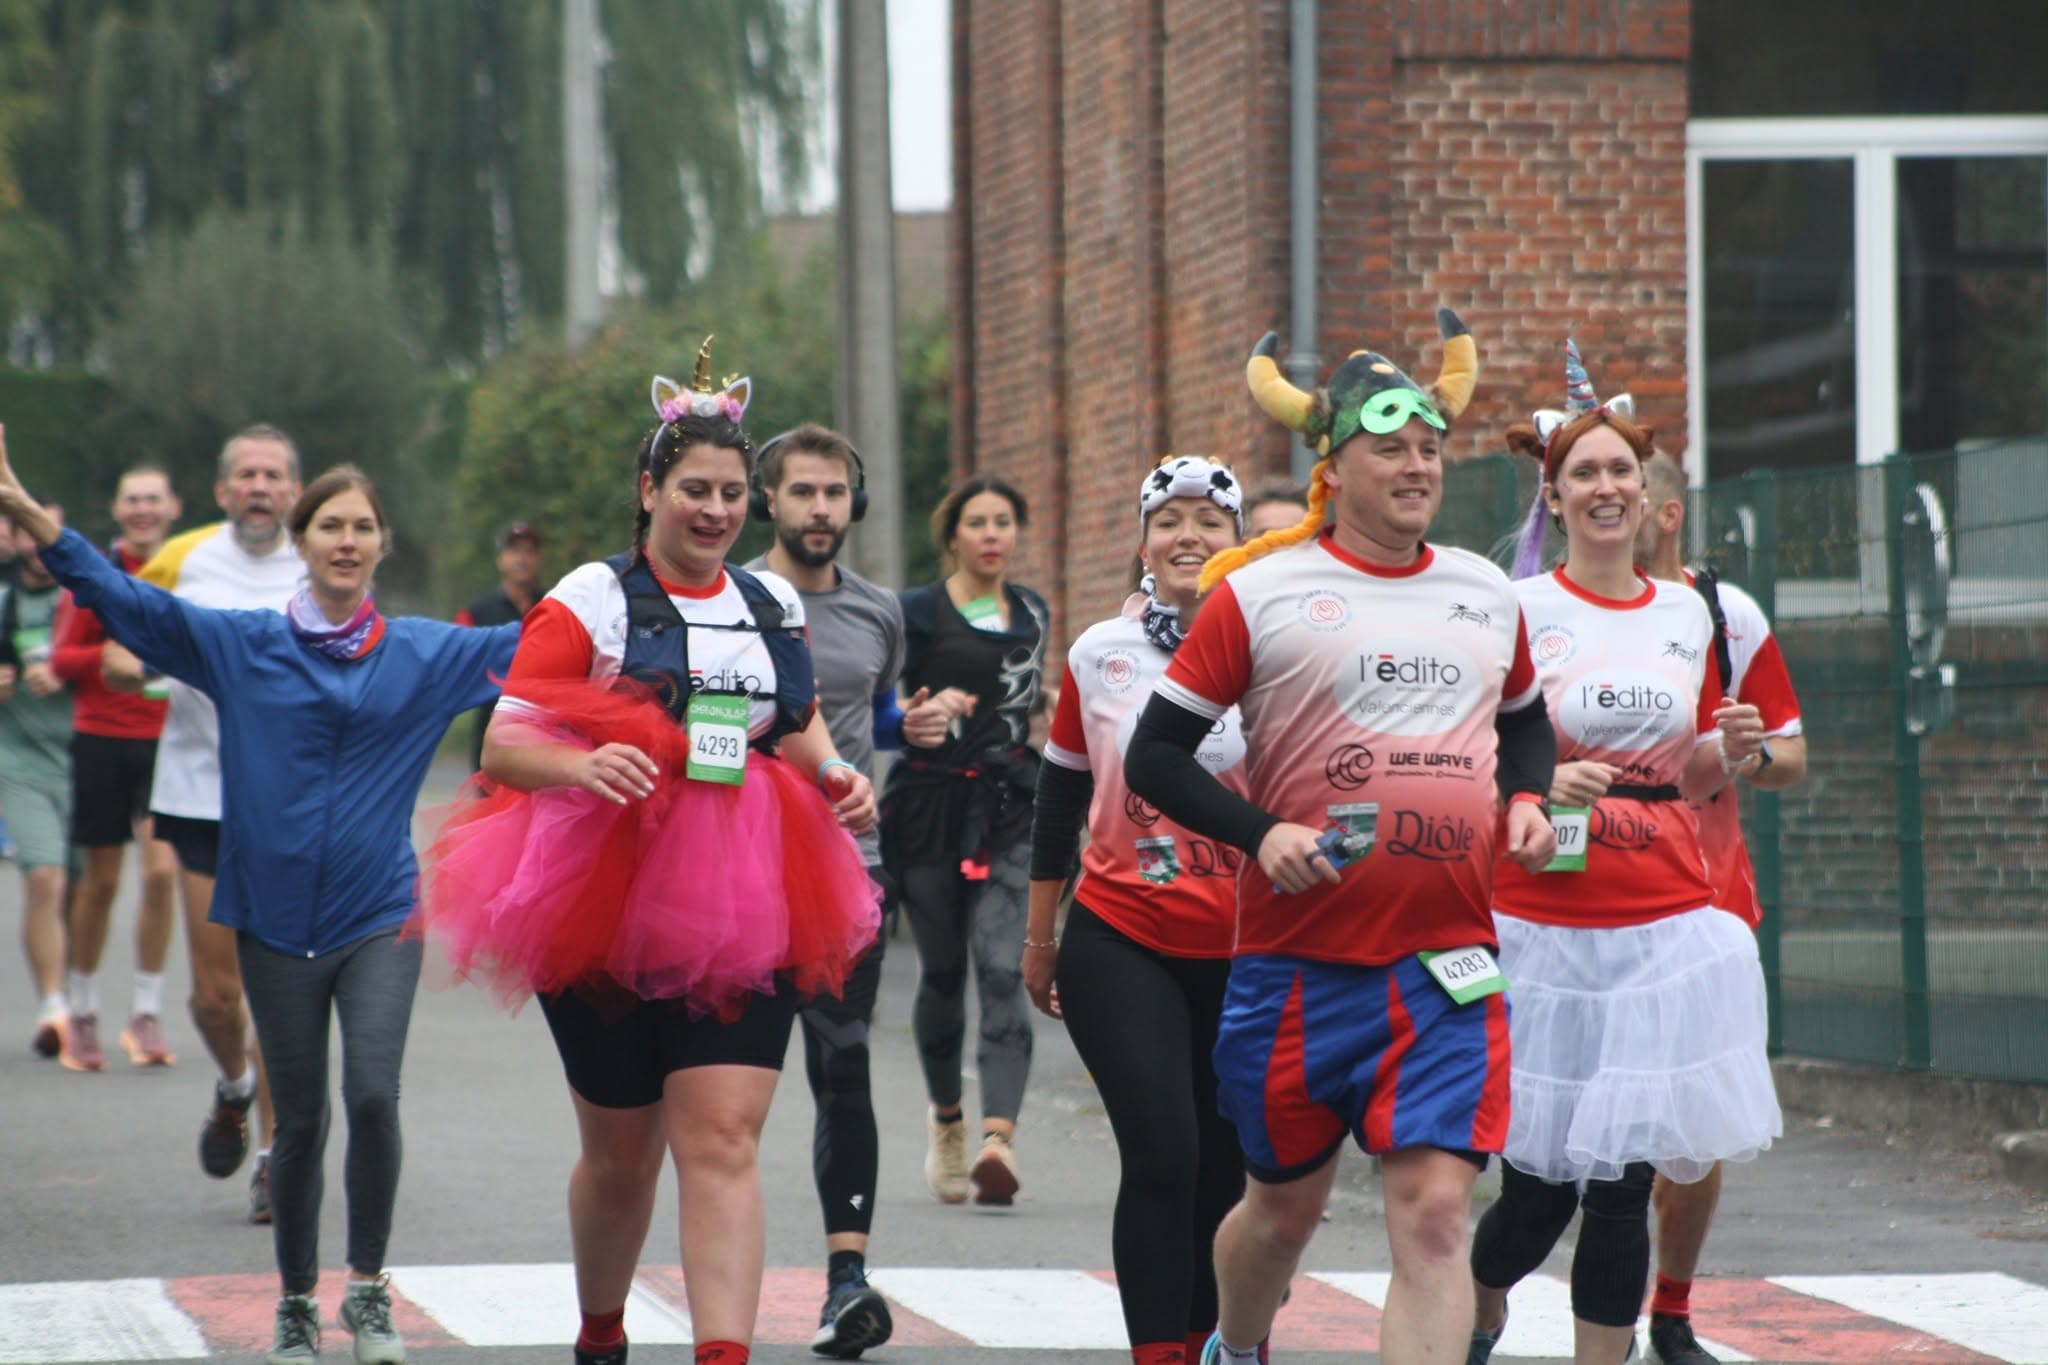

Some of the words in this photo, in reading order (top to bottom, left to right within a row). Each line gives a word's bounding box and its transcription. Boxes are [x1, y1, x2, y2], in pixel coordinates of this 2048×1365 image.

[697, 734, 739, 758] 4293
[1390, 752, 1421, 766] WE
[1424, 752, 1473, 770] WAVE
[1385, 809, 1475, 862] Diôle
[1443, 952, 1488, 980] 4283
